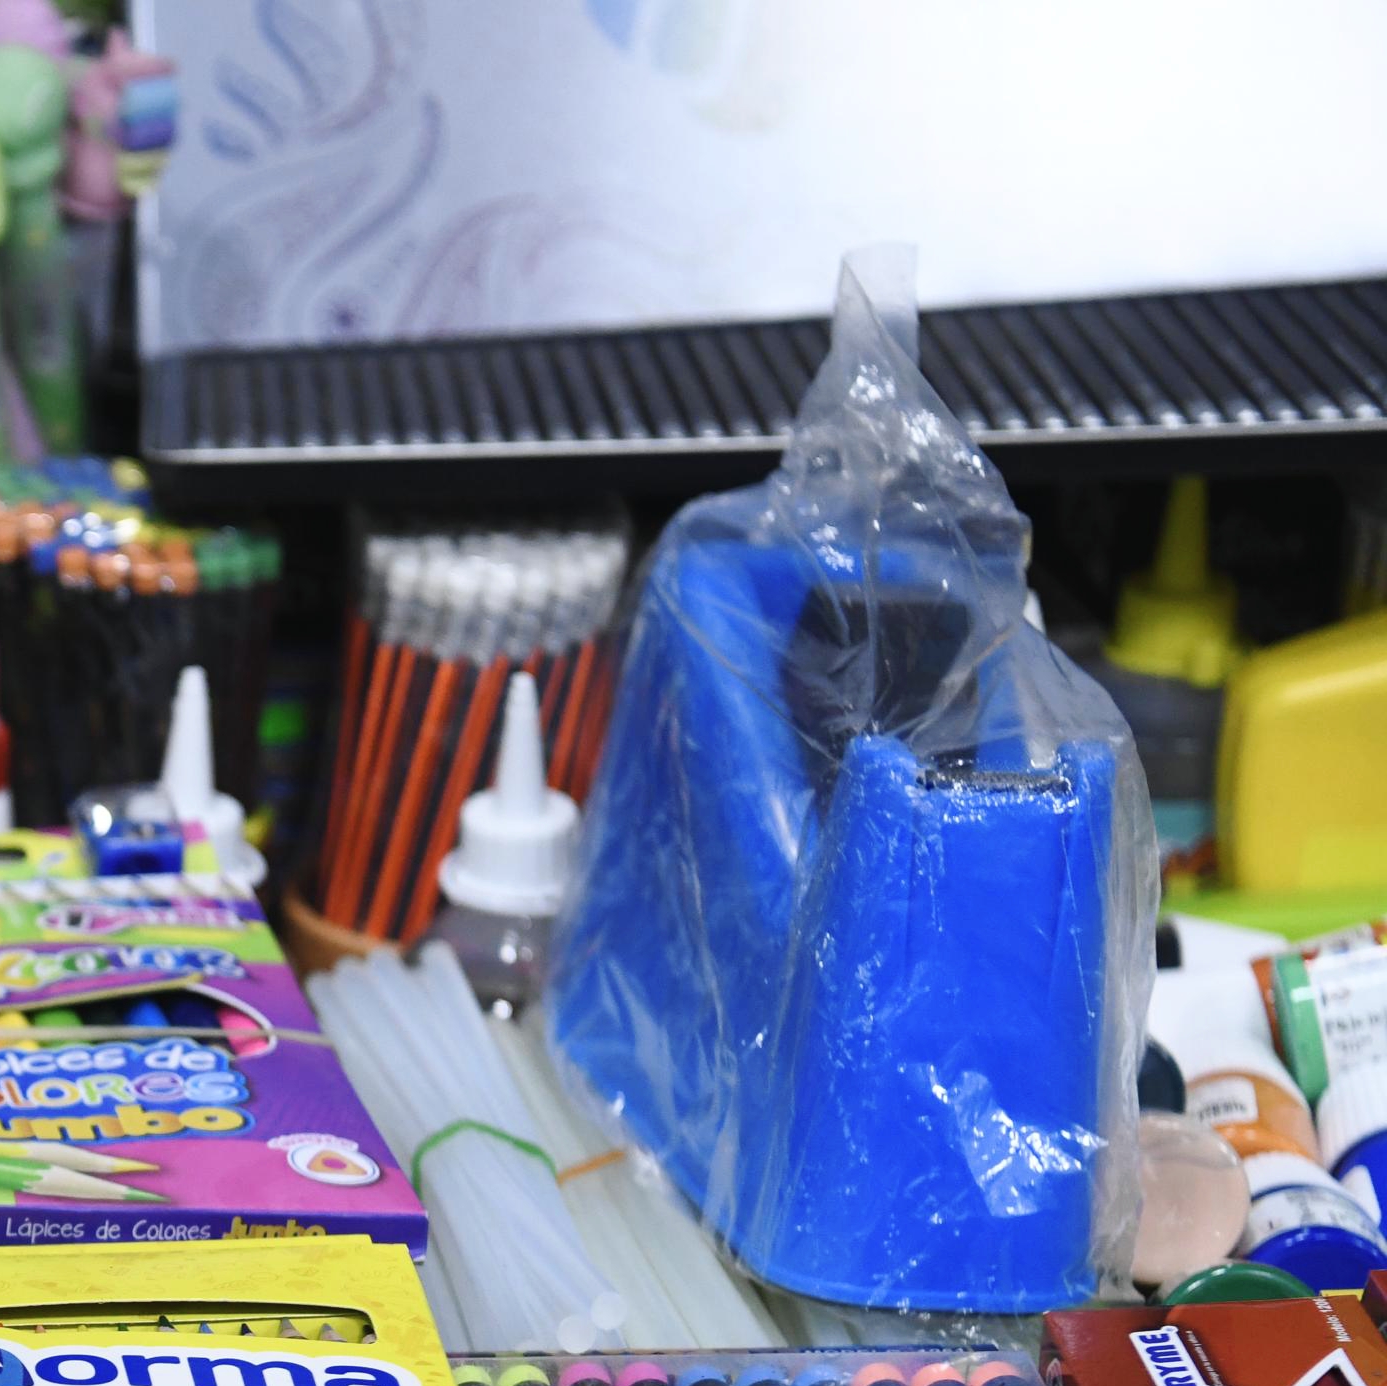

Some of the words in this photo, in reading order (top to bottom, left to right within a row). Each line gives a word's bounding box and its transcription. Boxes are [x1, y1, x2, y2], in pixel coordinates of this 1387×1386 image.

[144, 1043, 217, 1073] de
[4, 1213, 86, 1244] Lápices
[95, 1215, 124, 1239] de
